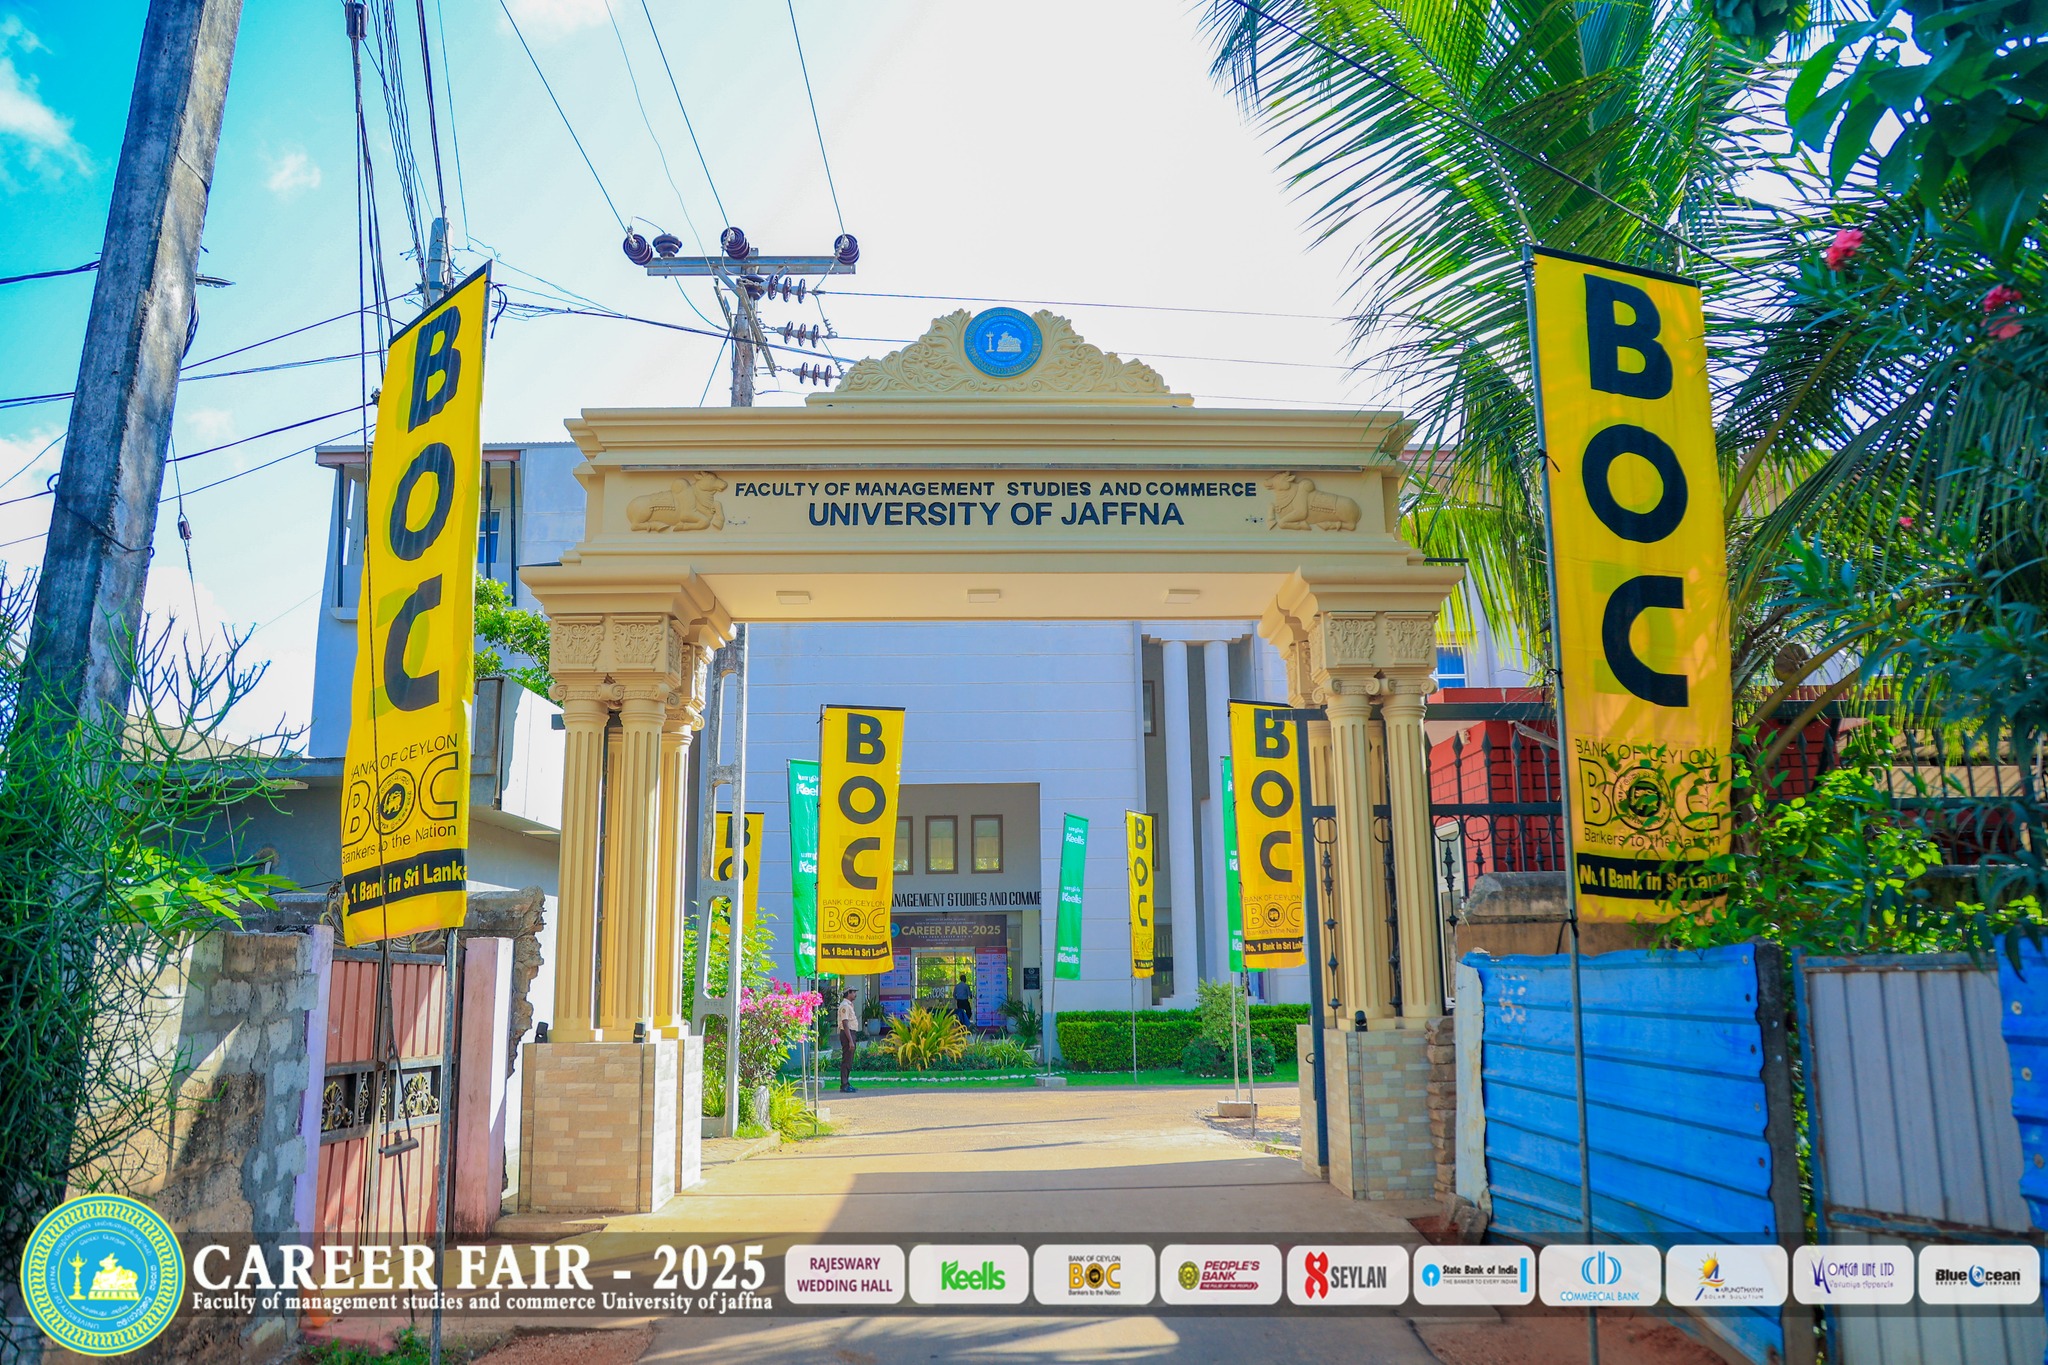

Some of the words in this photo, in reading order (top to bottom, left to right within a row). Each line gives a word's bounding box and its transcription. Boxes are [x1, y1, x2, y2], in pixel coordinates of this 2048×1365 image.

[735, 482, 819, 497] FACULTY
[824, 482, 850, 496] OF
[855, 481, 995, 496] MANAGEMENT
[1007, 481, 1092, 496] STUDIES
[1099, 482, 1142, 496] AND
[1146, 482, 1257, 497] COMMERCE
[1582, 273, 1689, 708] BOC
[384, 305, 461, 712] BOC
[808, 502, 1001, 526] UNIVERSITY
[1010, 502, 1052, 526] OF
[1061, 502, 1185, 525] JAFFNA
[351, 760, 378, 782] ANK
[381, 752, 398, 769] OF
[399, 733, 458, 762] CEYLON
[1575, 738, 1611, 758] BANK
[1618, 744, 1641, 760] OF
[342, 751, 459, 848] BOC
[796, 783, 818, 796] Keel
[838, 712, 887, 890] BOC
[1579, 757, 1720, 832] BOC
[392, 834, 411, 849] the
[416, 822, 456, 842] Nation
[1065, 832, 1085, 845] Keells
[1584, 828, 1625, 846] Bankers
[1631, 836, 1645, 847] to
[1675, 836, 1720, 849] Natn
[352, 883, 357, 904] 1
[388, 873, 402, 893] in
[403, 865, 420, 889] Sri
[1600, 866, 1606, 887] 1
[1608, 867, 1643, 890] Bank
[1646, 871, 1662, 890] in
[1666, 872, 1688, 891] Sr
[891, 892, 946, 907] ANAGEMENT
[947, 892, 987, 907] STUDIES
[988, 892, 1008, 906] AND
[1009, 891, 1041, 906] COMME
[823, 906, 885, 933] BOC
[1245, 902, 1302, 929] BOC
[901, 925, 942, 936] CAREER
[836, 947, 853, 956] Bank
[853, 947, 860, 956] in
[861, 948, 871, 957] Sri
[1282, 942, 1291, 950] Sri
